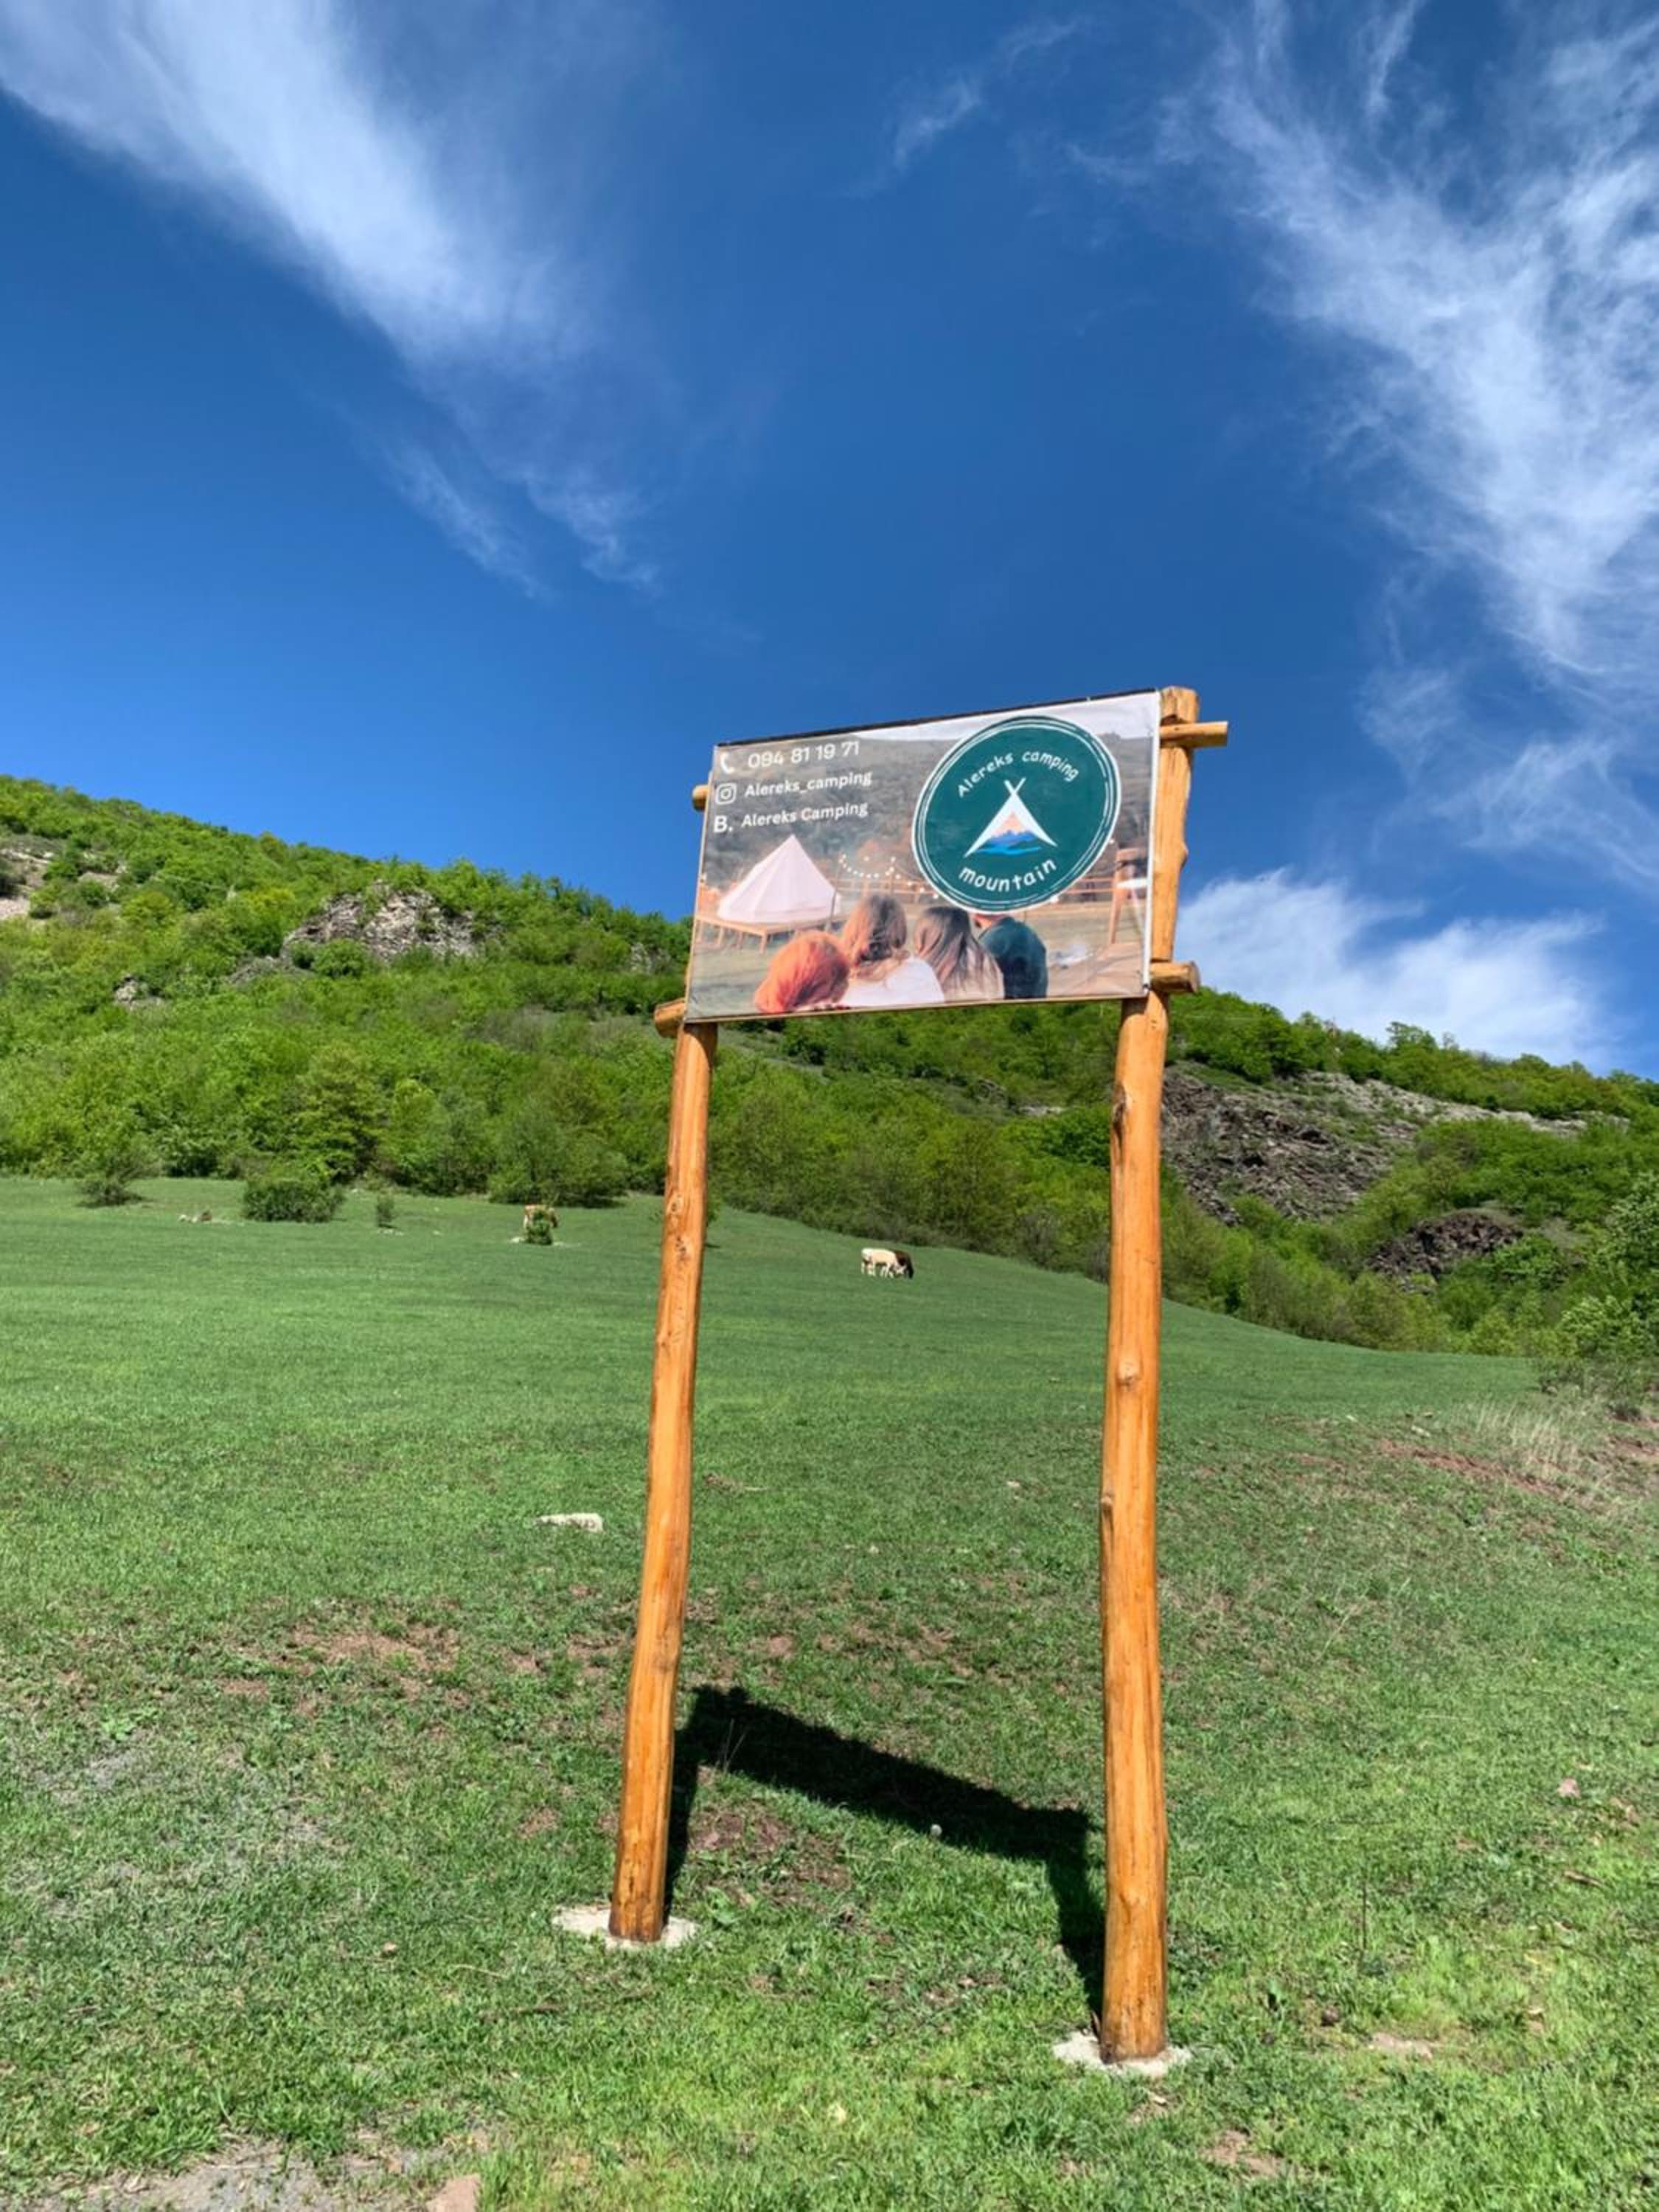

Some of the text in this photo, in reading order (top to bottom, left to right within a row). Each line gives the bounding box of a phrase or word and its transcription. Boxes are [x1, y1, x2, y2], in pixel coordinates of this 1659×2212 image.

[748, 741, 860, 768] 094 81 19 71
[744, 771, 873, 798] Alereks_camping
[958, 751, 1079, 798] Alereks camping
[713, 802, 869, 833] B. Alereks Camping
[959, 858, 1057, 892] mountain
